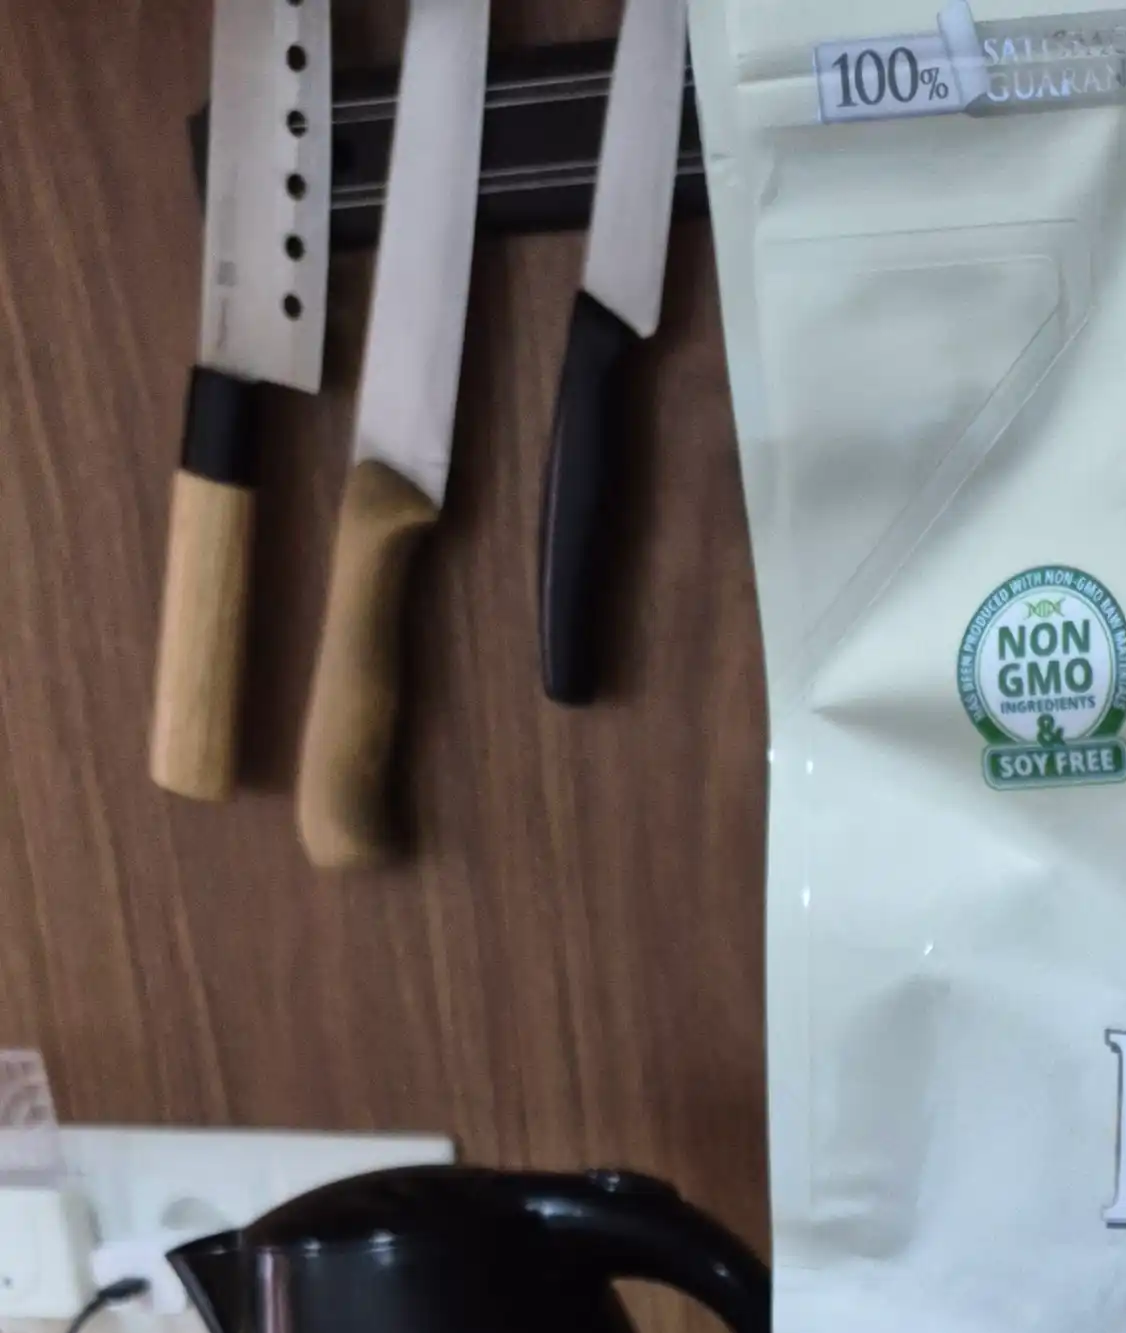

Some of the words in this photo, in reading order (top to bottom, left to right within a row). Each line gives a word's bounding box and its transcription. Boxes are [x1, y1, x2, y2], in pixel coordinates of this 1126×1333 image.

[831, 46, 949, 108] 100%
[963, 588, 1009, 653] PRODUCED
[1009, 571, 1042, 594] WITH
[1044, 569, 1103, 602] NON-GMO
[998, 619, 1091, 661] NON
[997, 658, 1093, 698] GMO
[1001, 695, 1096, 714] INGREDIENTS
[1036, 713, 1066, 747] &
[1000, 752, 1048, 778] SOY
[1056, 748, 1115, 776] FREE
